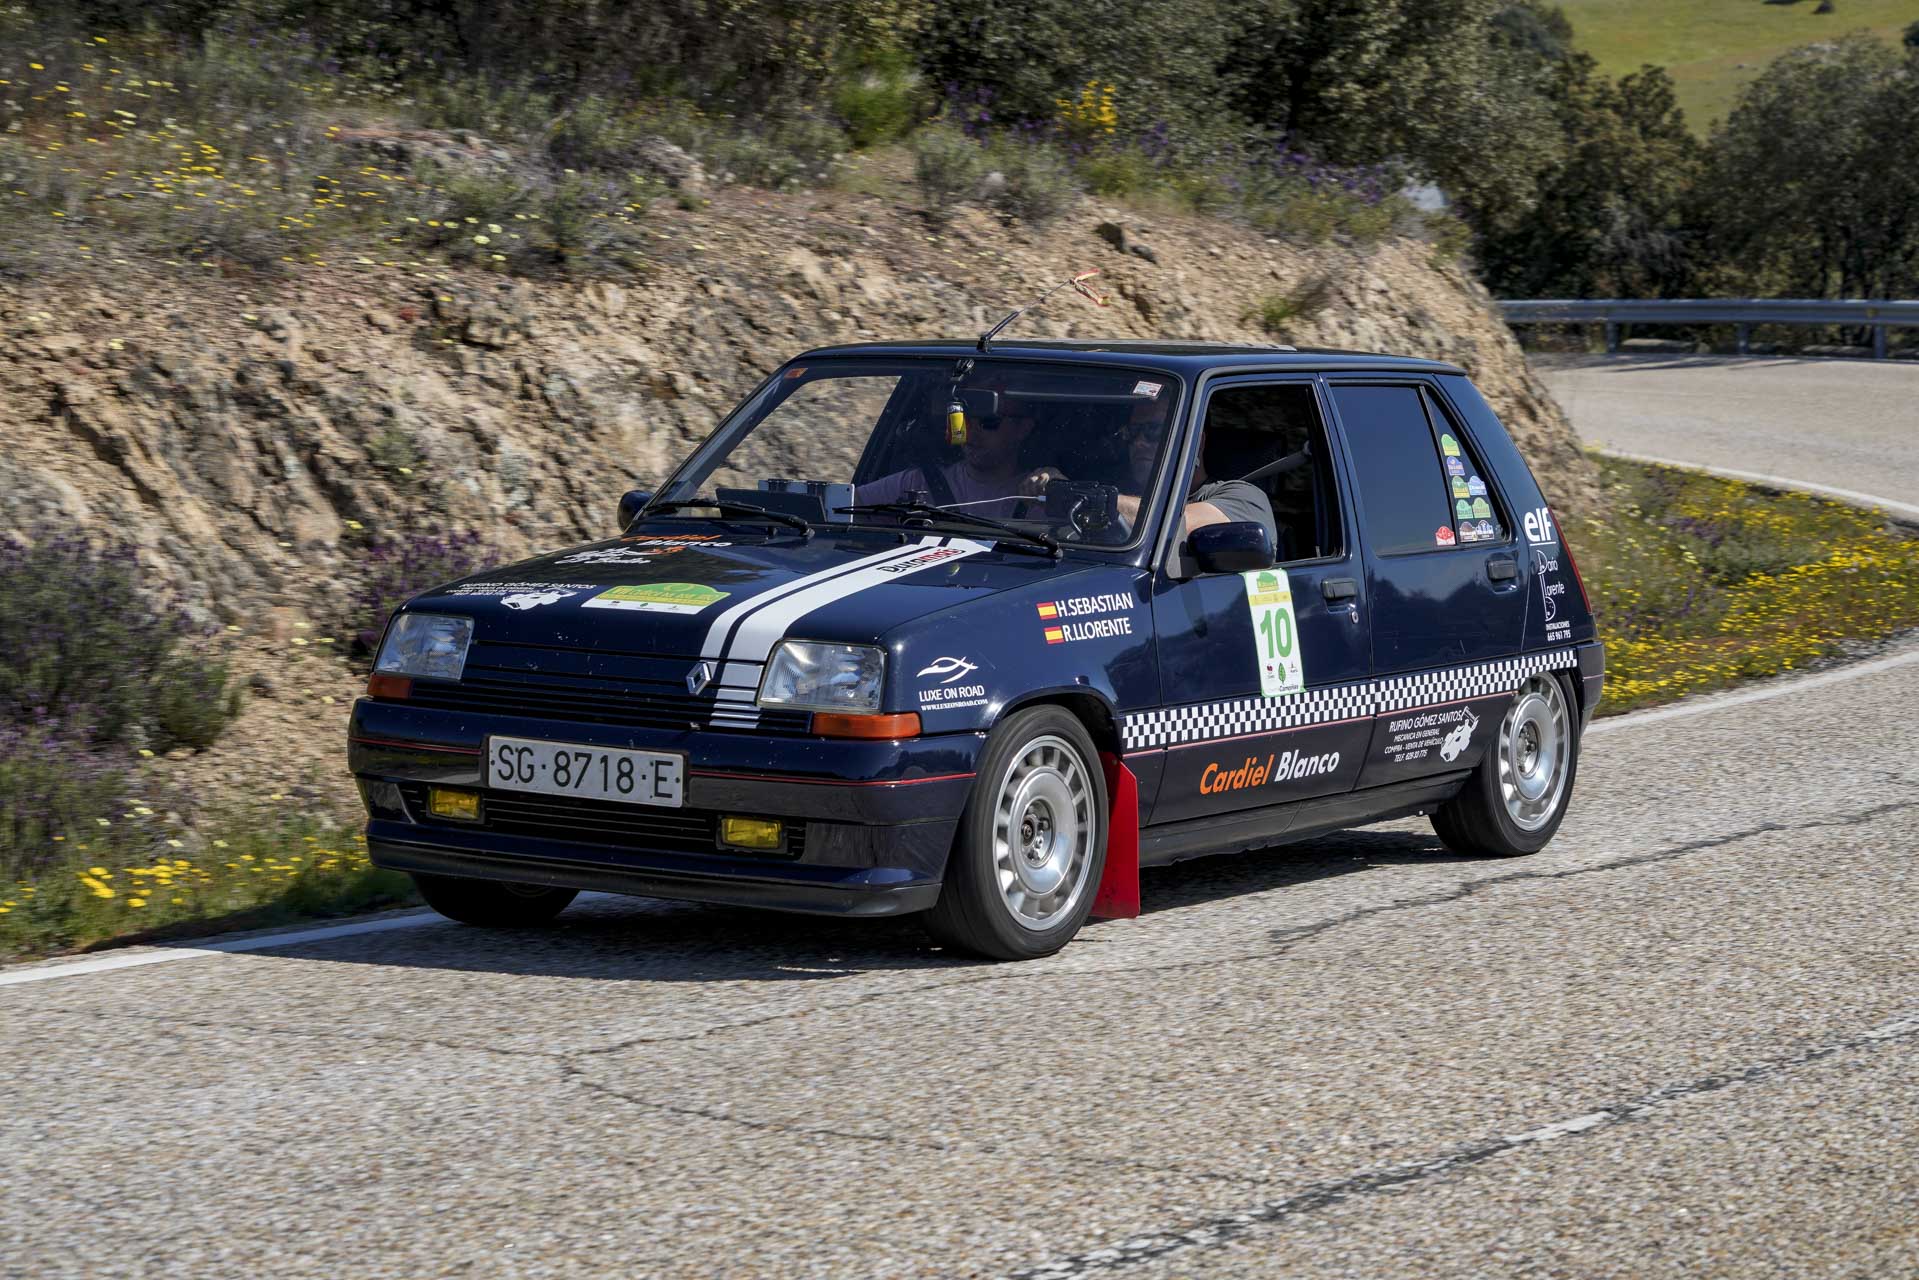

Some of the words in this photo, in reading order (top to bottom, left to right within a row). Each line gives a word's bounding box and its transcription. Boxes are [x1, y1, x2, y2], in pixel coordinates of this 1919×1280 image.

[1524, 507, 1551, 542] elf
[1062, 617, 1132, 642] R.LLORENTE
[1260, 607, 1292, 659] 10
[919, 688, 943, 702] LUXE
[943, 687, 958, 700] ON
[958, 685, 985, 698] ROAD
[1389, 720, 1413, 733] RUFINO
[1413, 713, 1438, 729] GÓMEZ
[1438, 710, 1462, 724] SANTOS
[1200, 753, 1275, 795] Cardiel
[1274, 749, 1340, 782] Blanco
